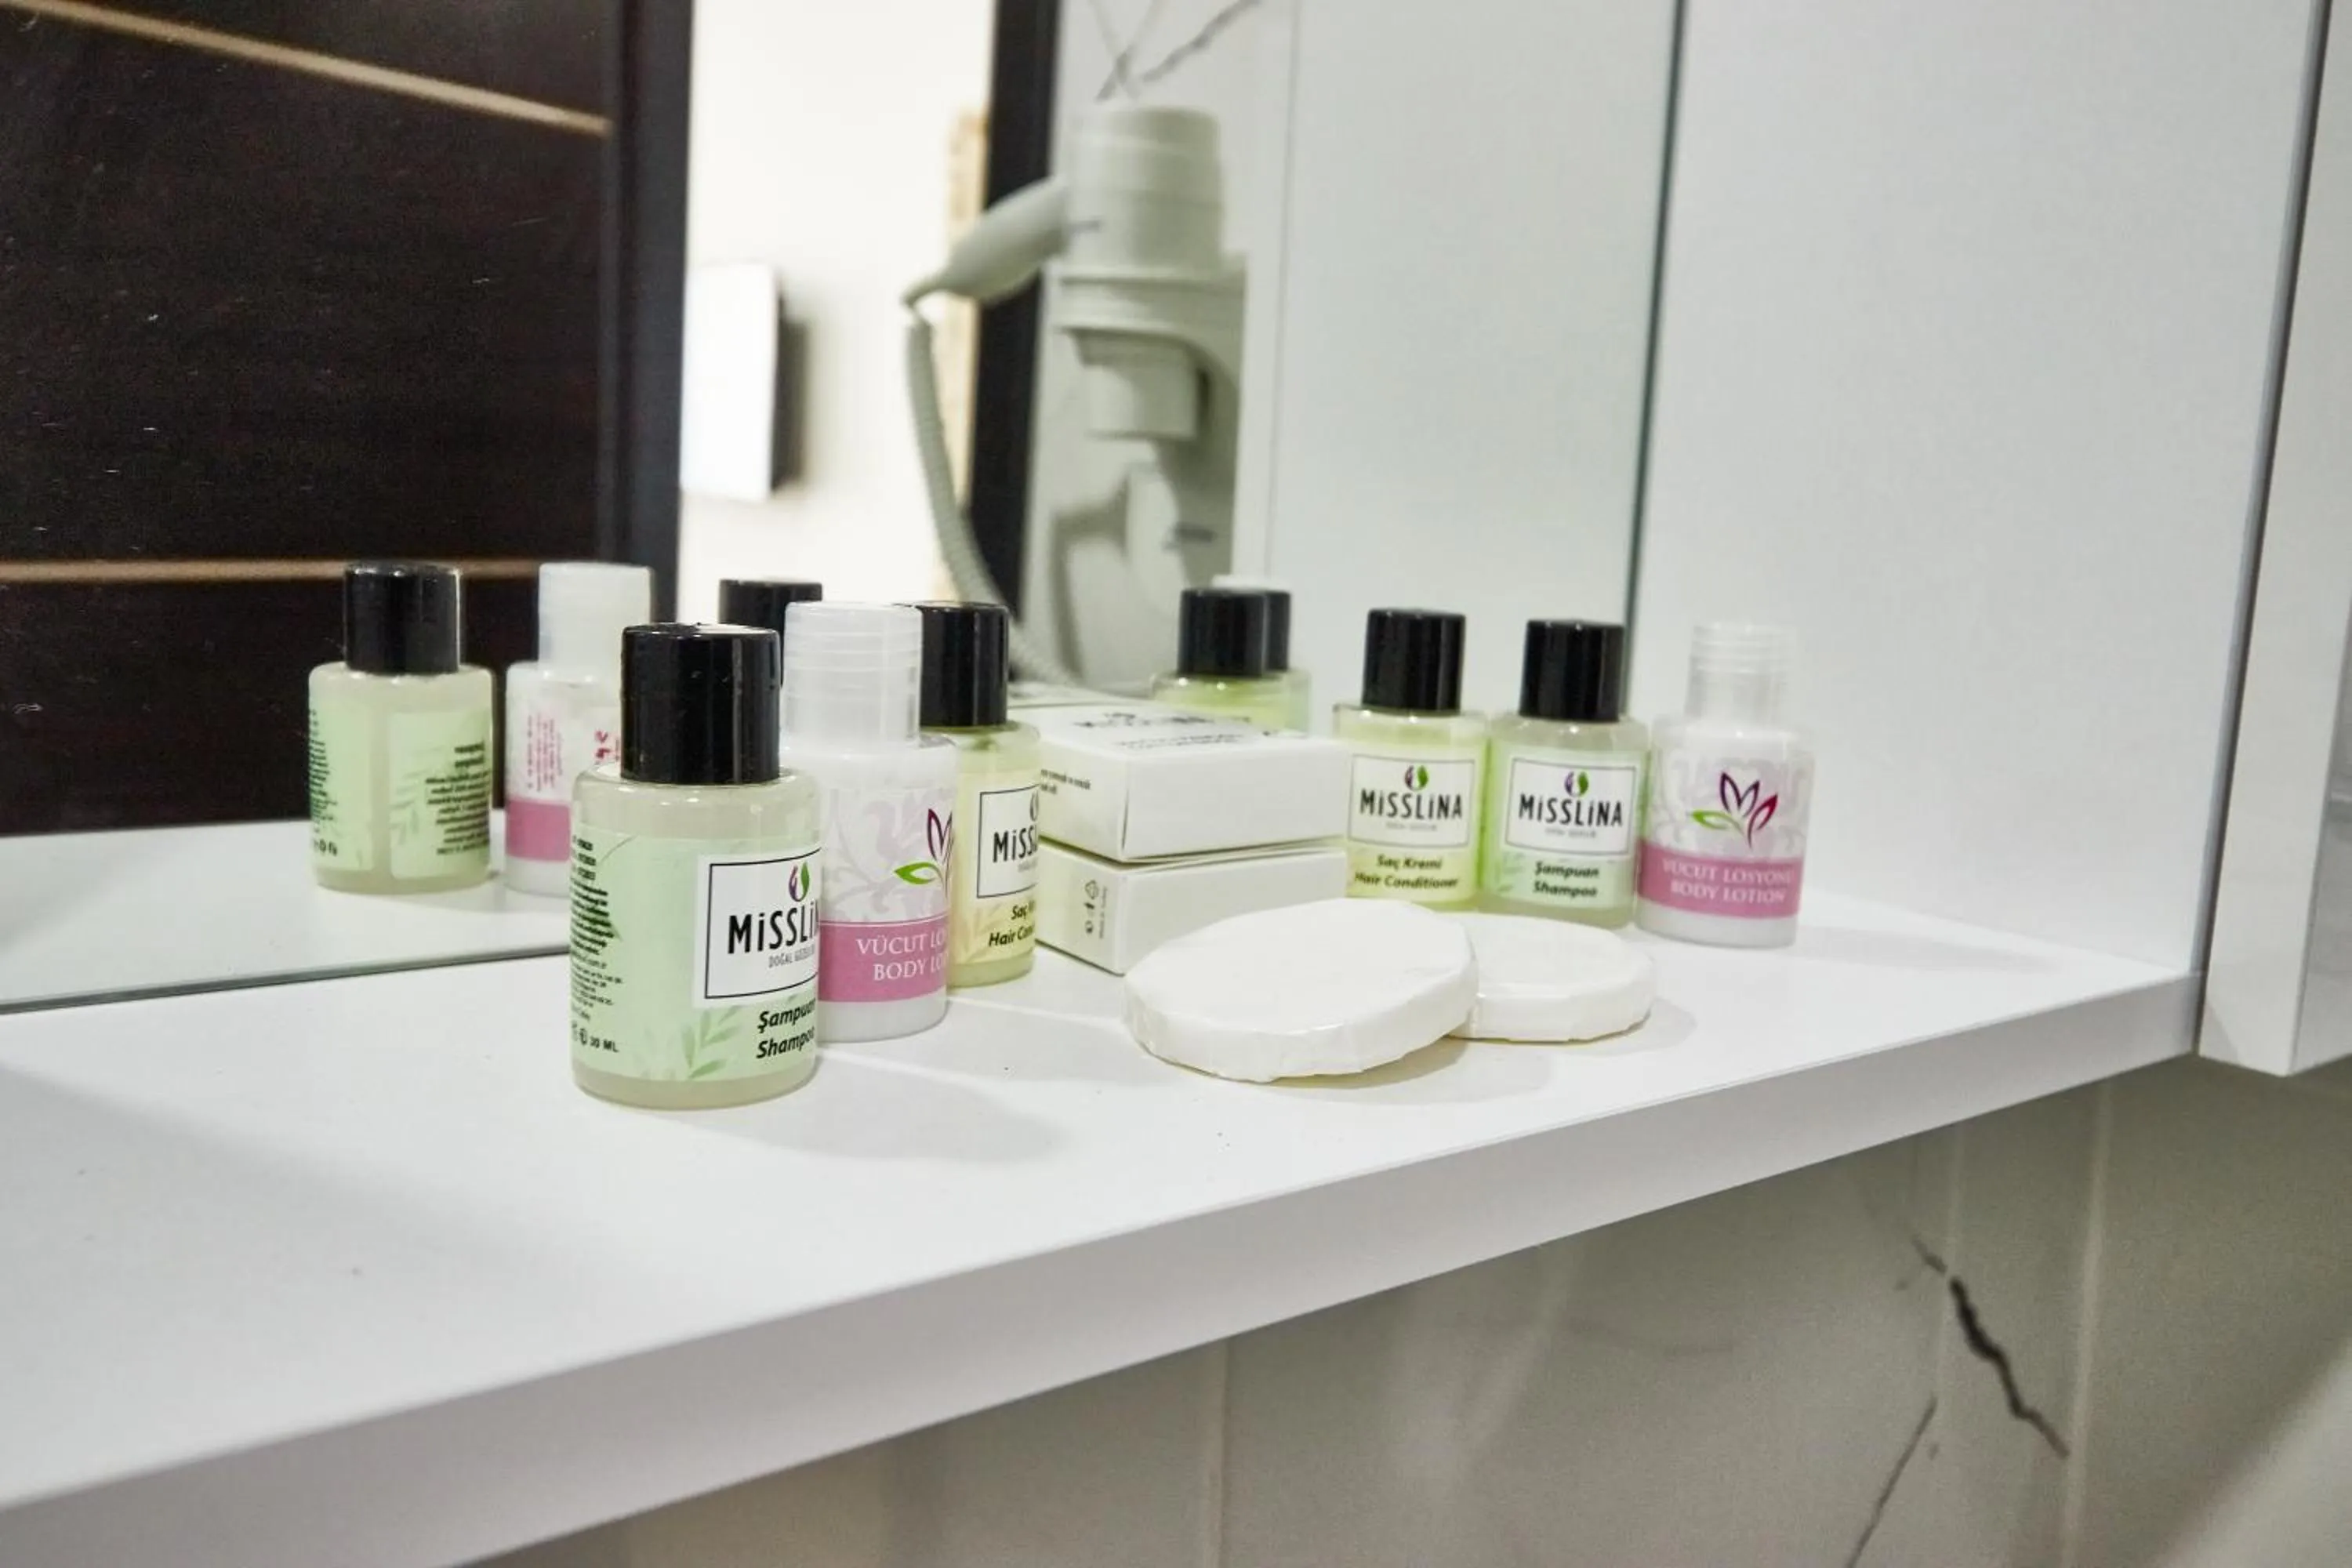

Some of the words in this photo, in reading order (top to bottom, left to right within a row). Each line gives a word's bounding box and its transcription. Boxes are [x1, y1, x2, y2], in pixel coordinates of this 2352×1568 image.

[1377, 854, 1399, 871] Saç
[1534, 861, 1599, 879] Şampuan
[1354, 871, 1381, 885] Hair
[1384, 874, 1458, 889] Conditioner
[1533, 880, 1598, 898] Shampoo
[1671, 880, 1720, 900] BODY
[1723, 887, 1787, 904] LOTION
[856, 933, 928, 956] VÜCUT
[989, 928, 1016, 948] Hair
[873, 957, 927, 981] BODY
